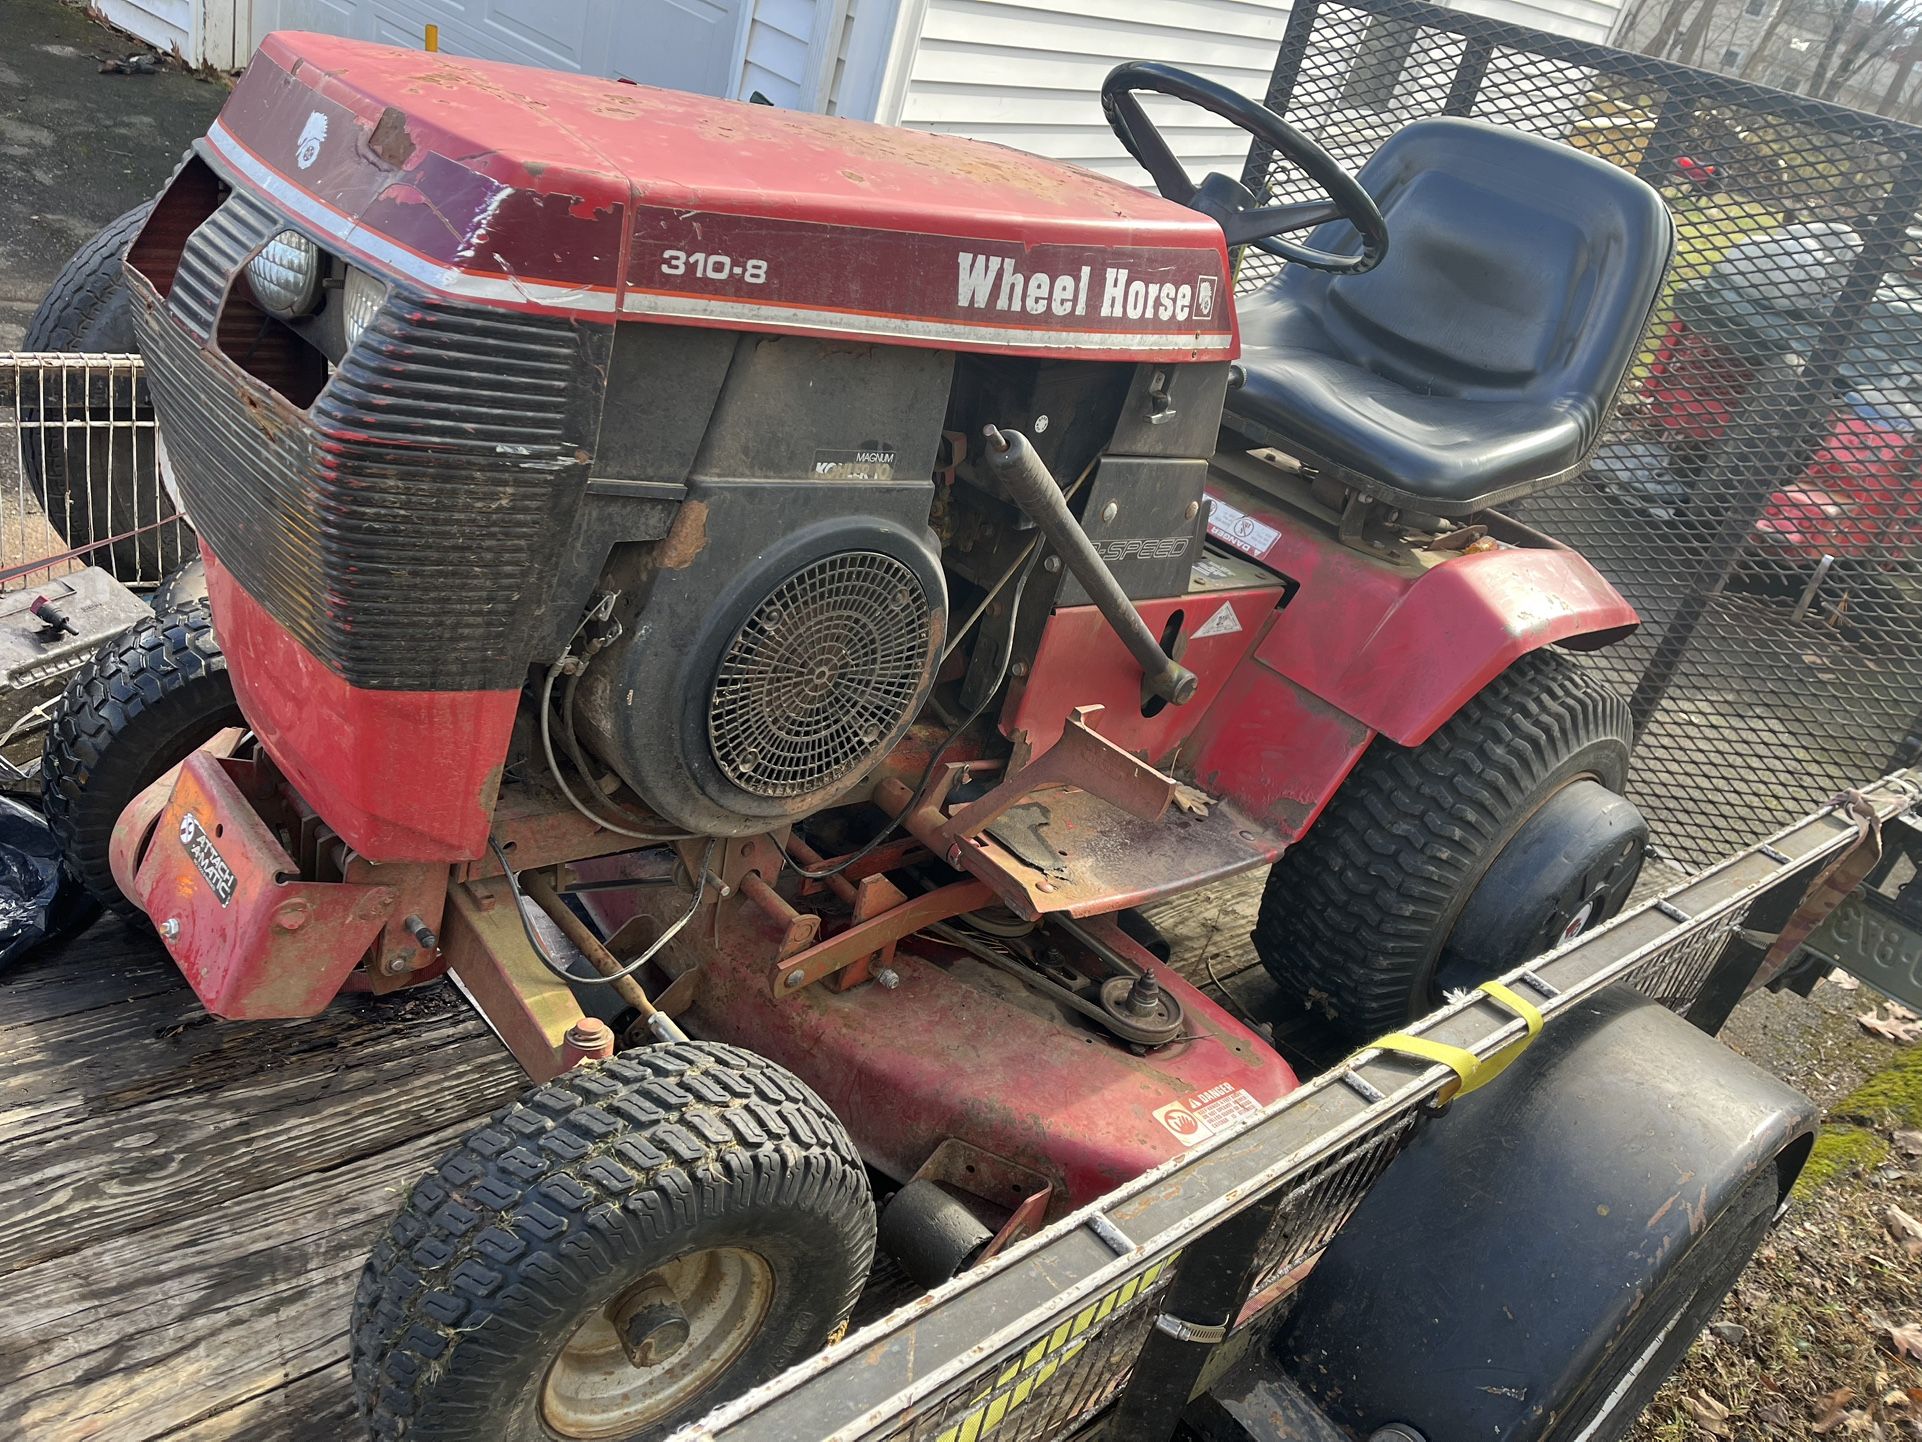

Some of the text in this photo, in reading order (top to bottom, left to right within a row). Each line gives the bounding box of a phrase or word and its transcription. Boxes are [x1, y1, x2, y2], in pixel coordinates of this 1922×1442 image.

[661, 249, 768, 284] 310-8
[958, 252, 1192, 321] Wheel Horse
[856, 452, 894, 463] MAGNUM
[1211, 526, 1251, 552] DANGER
[196, 835, 234, 887] ATTACH
[1197, 1082, 1236, 1104] DANGER
